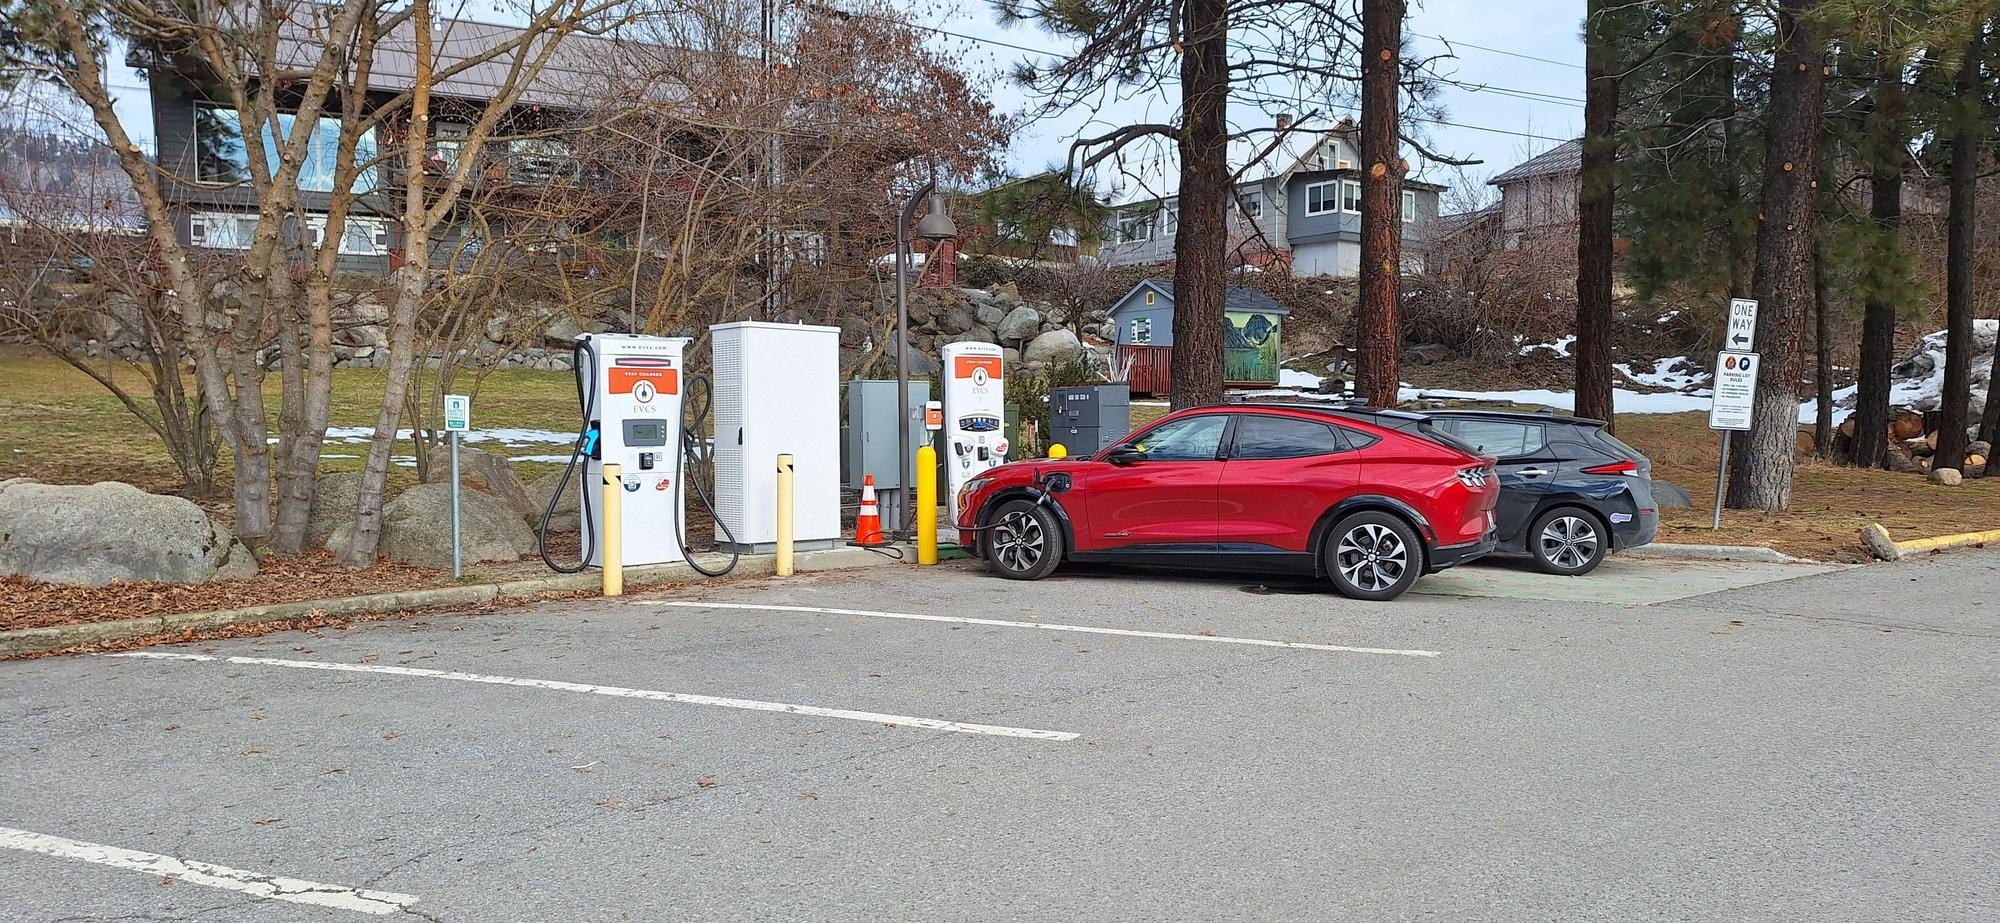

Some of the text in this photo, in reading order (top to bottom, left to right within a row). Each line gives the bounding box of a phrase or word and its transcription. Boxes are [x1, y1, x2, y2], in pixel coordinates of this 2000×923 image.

[1735, 304, 1753, 317] ONE
[1732, 318, 1752, 331] WAY
[1742, 360, 1749, 368] P
[634, 405, 656, 413] EVCS
